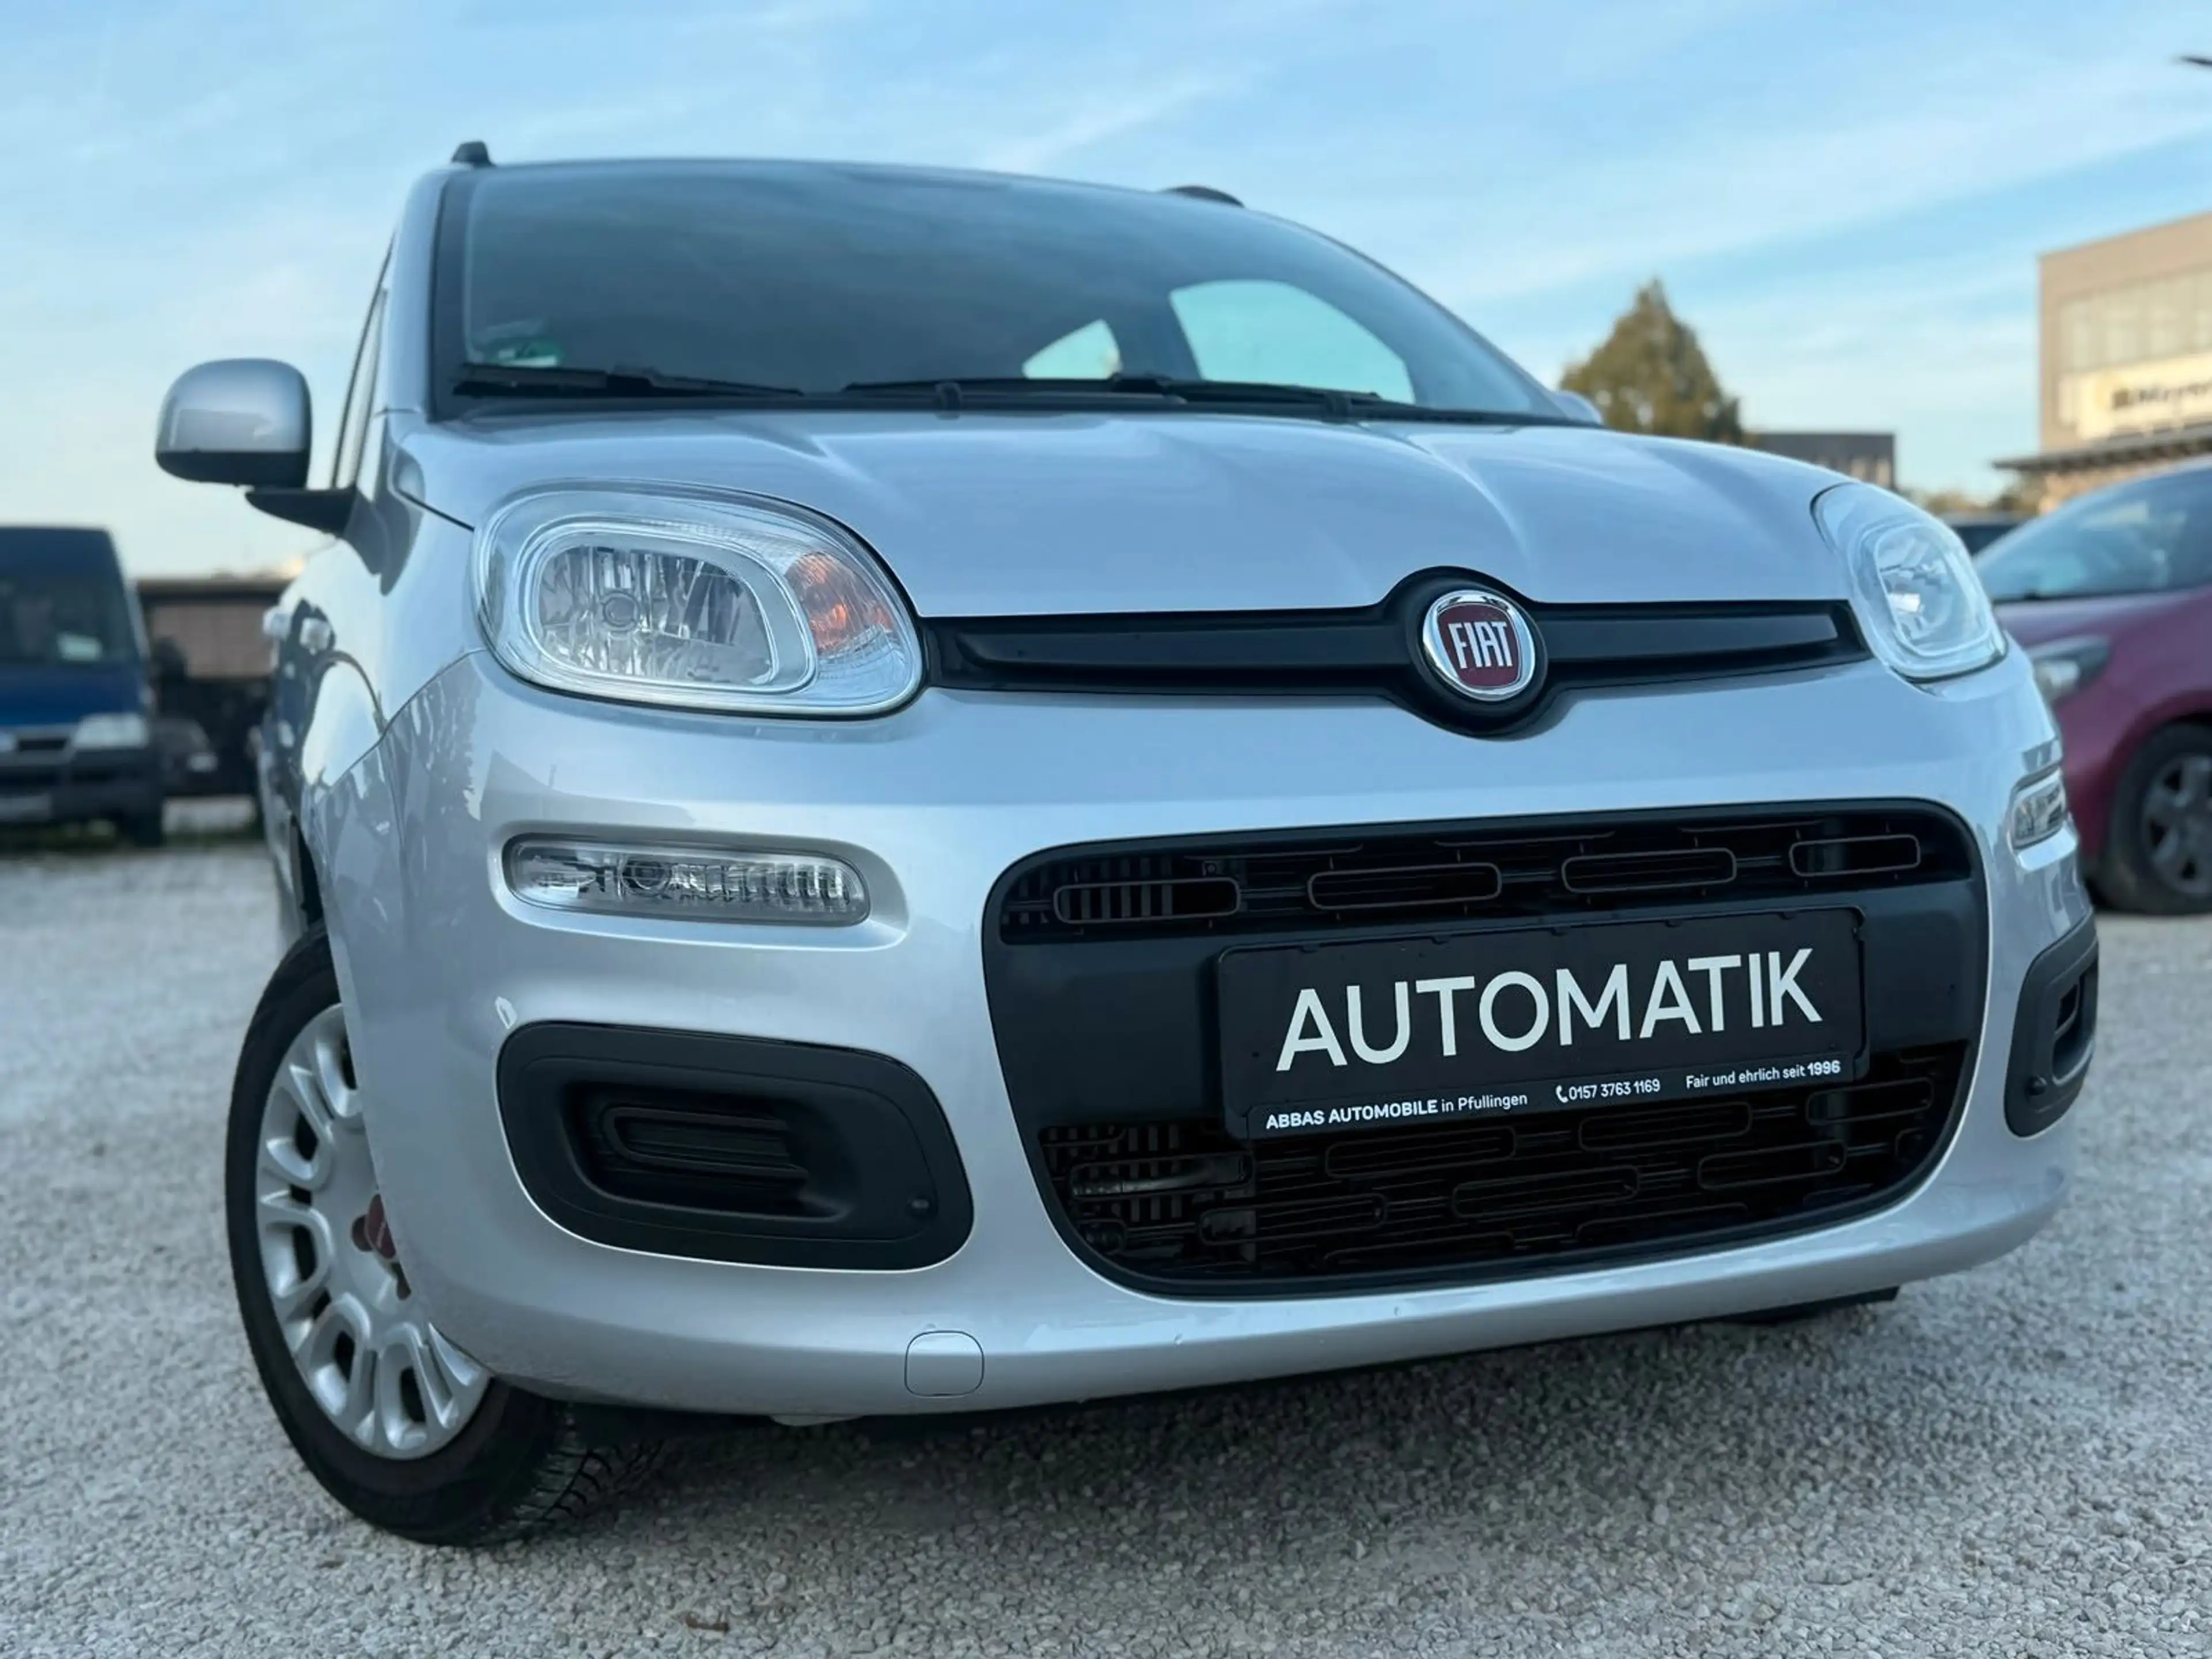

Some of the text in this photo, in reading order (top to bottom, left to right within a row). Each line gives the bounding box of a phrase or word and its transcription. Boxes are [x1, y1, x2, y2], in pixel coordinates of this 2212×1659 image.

[1448, 620, 1513, 669] FIAT
[1275, 948, 1823, 1071] AUTOMATIK
[1569, 1078, 1661, 1100] 0157 3763 1169
[1686, 1059, 1841, 1089] Fair und ehrlich seit 1996
[1266, 1094, 1528, 1129] ABBAS AUTOMOBILE in Pfullingen
